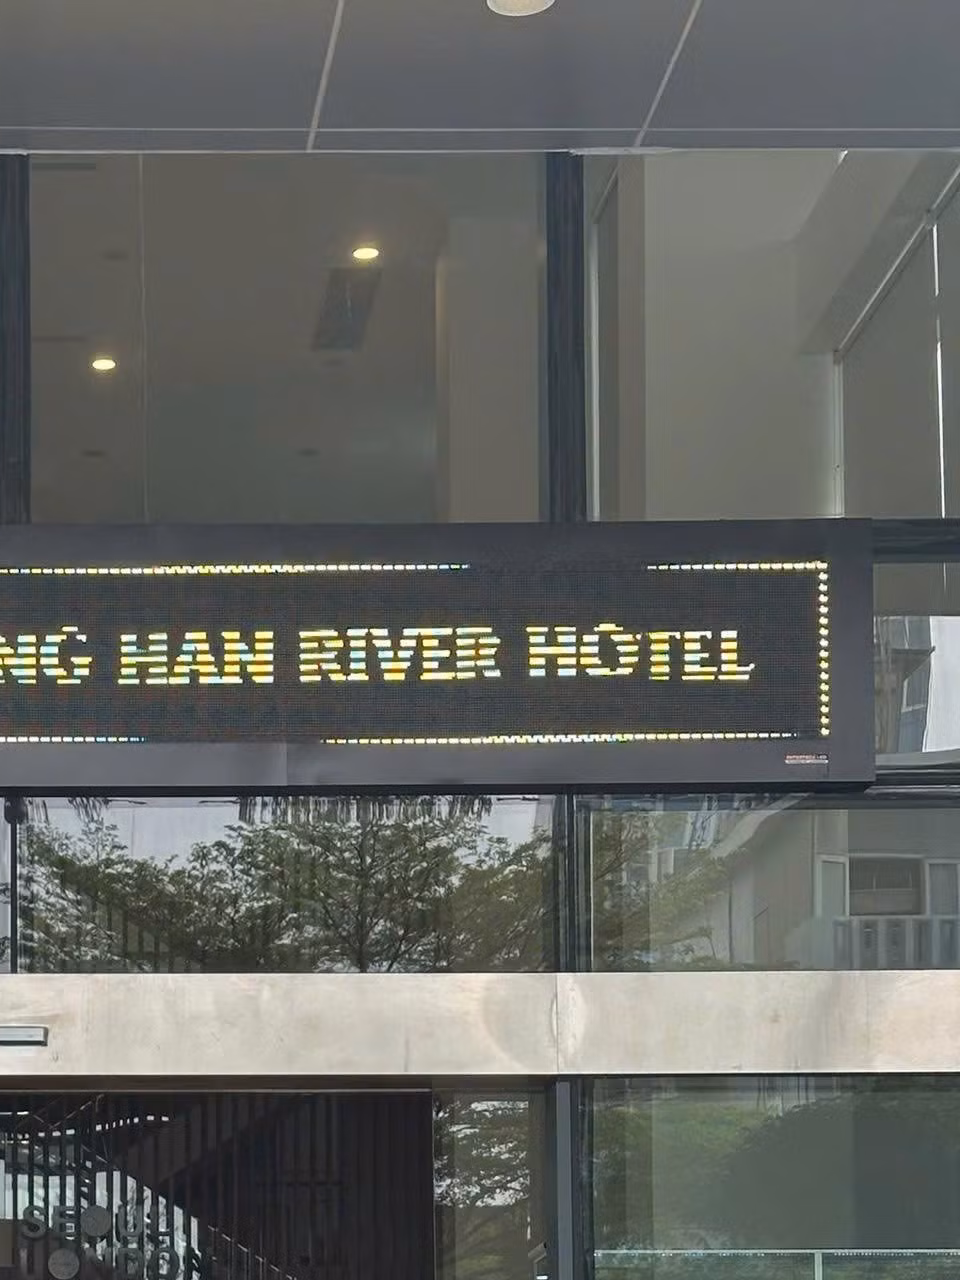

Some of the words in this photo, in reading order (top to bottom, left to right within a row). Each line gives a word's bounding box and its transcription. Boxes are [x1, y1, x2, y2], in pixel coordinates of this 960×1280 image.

[118, 632, 273, 684] HAN
[299, 628, 500, 682] RIVER
[526, 624, 755, 680] HOTEL
